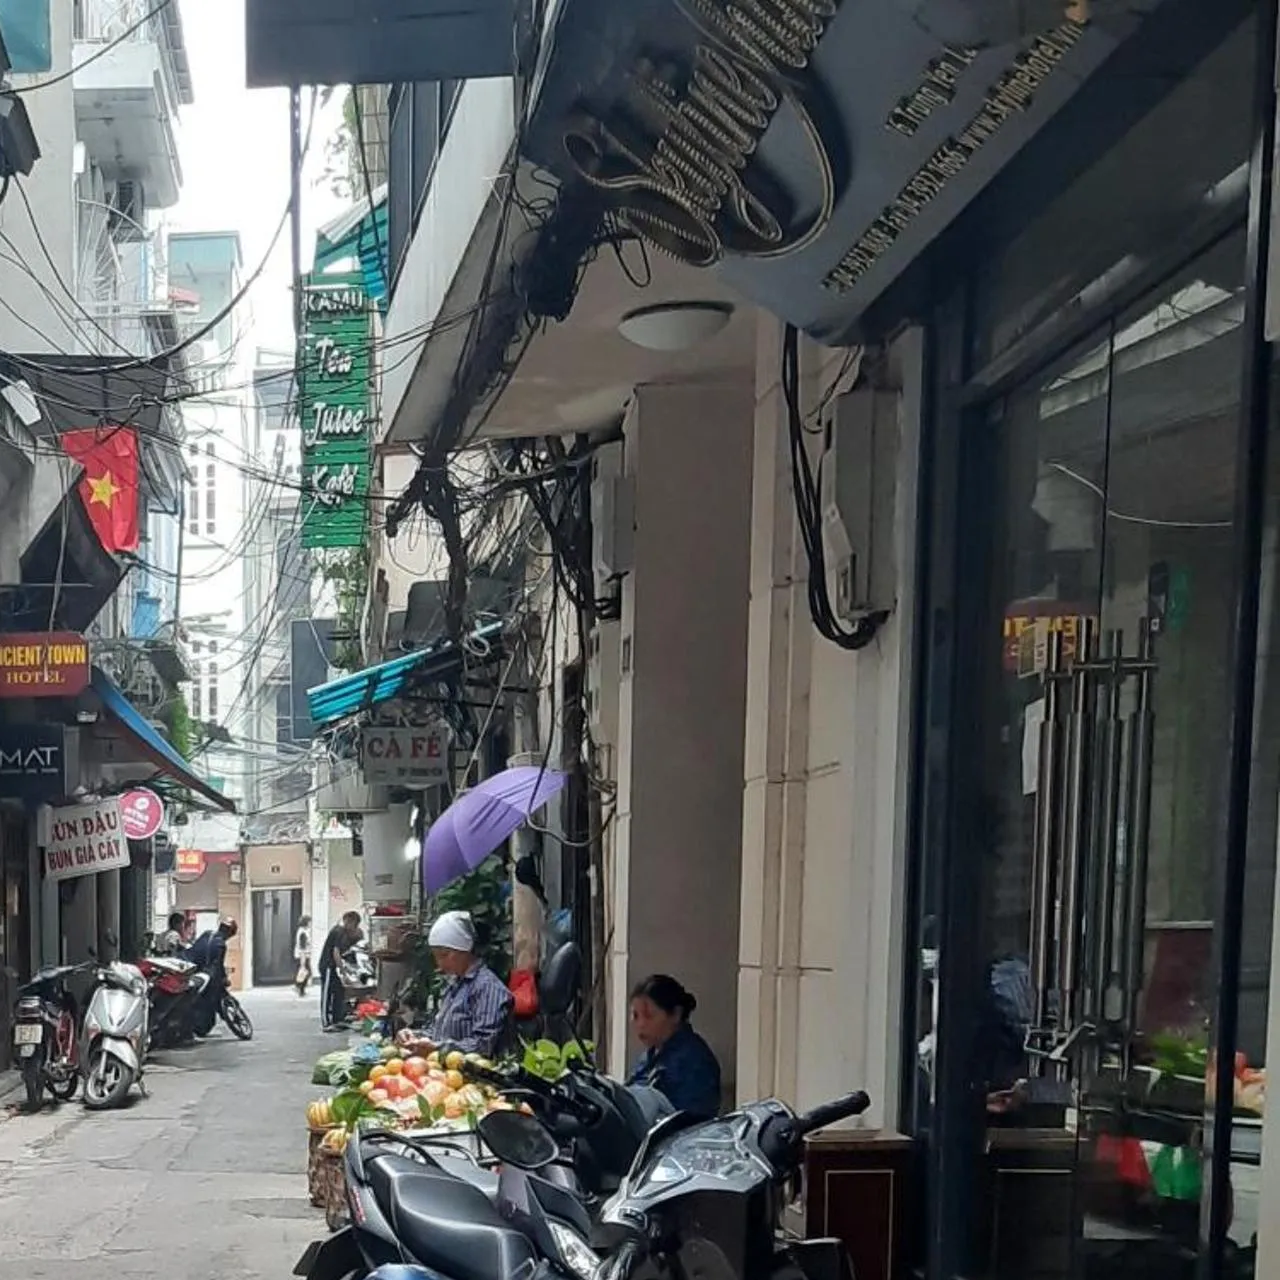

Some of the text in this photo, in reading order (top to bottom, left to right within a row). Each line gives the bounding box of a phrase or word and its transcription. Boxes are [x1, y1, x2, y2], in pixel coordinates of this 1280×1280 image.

[304, 402, 365, 447] Juice
[47, 644, 86, 665] TOWN
[6, 671, 66, 684] HOTEL
[367, 731, 402, 758] CÀ
[83, 810, 118, 838] ĐẬU
